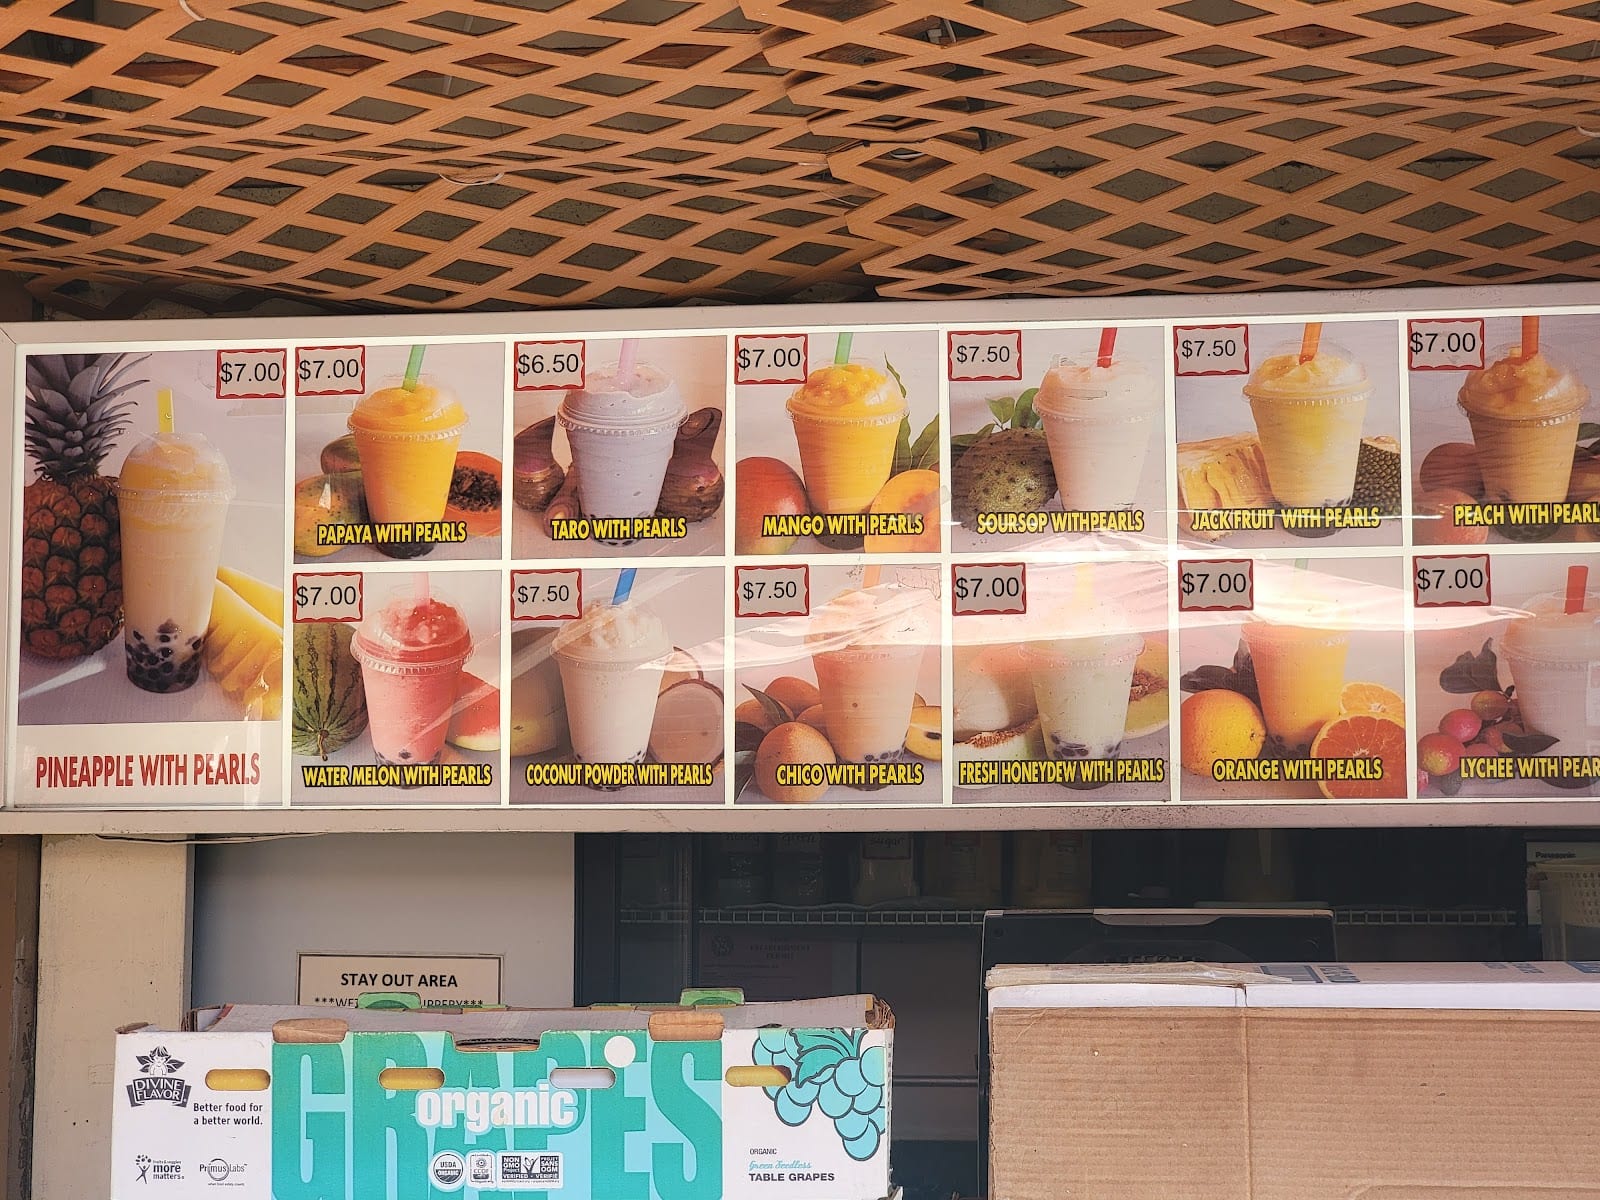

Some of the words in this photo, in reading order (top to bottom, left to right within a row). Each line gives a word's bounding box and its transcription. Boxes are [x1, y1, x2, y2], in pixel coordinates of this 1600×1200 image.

[956, 344, 1011, 365] $7.50
[1181, 338, 1237, 361] $7.50
[1409, 331, 1477, 357] $7.00
[298, 357, 360, 382] $7.00
[516, 352, 580, 376] $6.50
[736, 346, 802, 372] $7.00
[220, 361, 282, 385] $7.00
[763, 515, 825, 537] MANGO
[826, 514, 866, 535] WITH
[869, 513, 923, 534] PEARLS
[977, 512, 1048, 534] SOURSOP
[1280, 508, 1321, 529] WITH
[1324, 506, 1380, 528] PEARLS
[1454, 504, 1505, 527] PEACH
[1507, 503, 1549, 525] WITH
[1553, 502, 1600, 524] PEARL
[318, 524, 373, 545] PAPAYA
[374, 523, 412, 543] WITH
[414, 521, 467, 542] PEARLS
[551, 519, 590, 540] TARO
[592, 518, 631, 539] WITH
[633, 517, 687, 538] PEARLS
[742, 580, 798, 603] $7.50
[955, 576, 1021, 601] $7.00
[1182, 572, 1248, 597] $7.00
[1416, 568, 1484, 593] $7.00
[296, 584, 357, 609] $7.00
[517, 584, 571, 605] $7.50
[35, 755, 134, 788] PINEAPPLE
[138, 754, 188, 786] WITH
[193, 752, 261, 786] PEARLS
[403, 765, 439, 785] WITH
[442, 765, 492, 785] PEARLS
[526, 763, 583, 785] COCONUT
[584, 763, 635, 785] POWDER
[636, 763, 668, 785] WITH
[670, 763, 713, 785] PEARLS
[776, 764, 824, 786] CHICO
[825, 764, 866, 785] WITH
[869, 763, 923, 785] PEARLS
[960, 761, 999, 784] FRESH
[1001, 760, 1077, 784] HONEYDEW
[1079, 760, 1114, 783] WITH
[1117, 759, 1164, 782] PEARLS
[1213, 759, 1279, 782] ORANGE
[1282, 759, 1323, 780] WITH
[1327, 758, 1383, 780] PEARLS
[1460, 757, 1514, 779] LYCHEE
[1517, 757, 1559, 778] WITH
[1562, 757, 1600, 778] PEAR
[341, 973, 378, 986] STAY
[382, 974, 414, 987] OUT
[418, 975, 458, 987] AREA
[134, 1078, 184, 1091] DIVINE
[136, 1089, 180, 1101] FLAVOR
[193, 1103, 222, 1112] Better
[225, 1103, 246, 1112] food
[250, 1103, 263, 1112] for
[416, 1084, 574, 1130] organic
[193, 1117, 199, 1125] a
[202, 1116, 231, 1125] better
[233, 1116, 263, 1125] world.
[153, 1164, 181, 1173] more
[748, 1160, 773, 1171] Green
[775, 1160, 812, 1169] Seedless
[749, 1173, 785, 1181] TABLE
[788, 1173, 835, 1182] GRAPES
